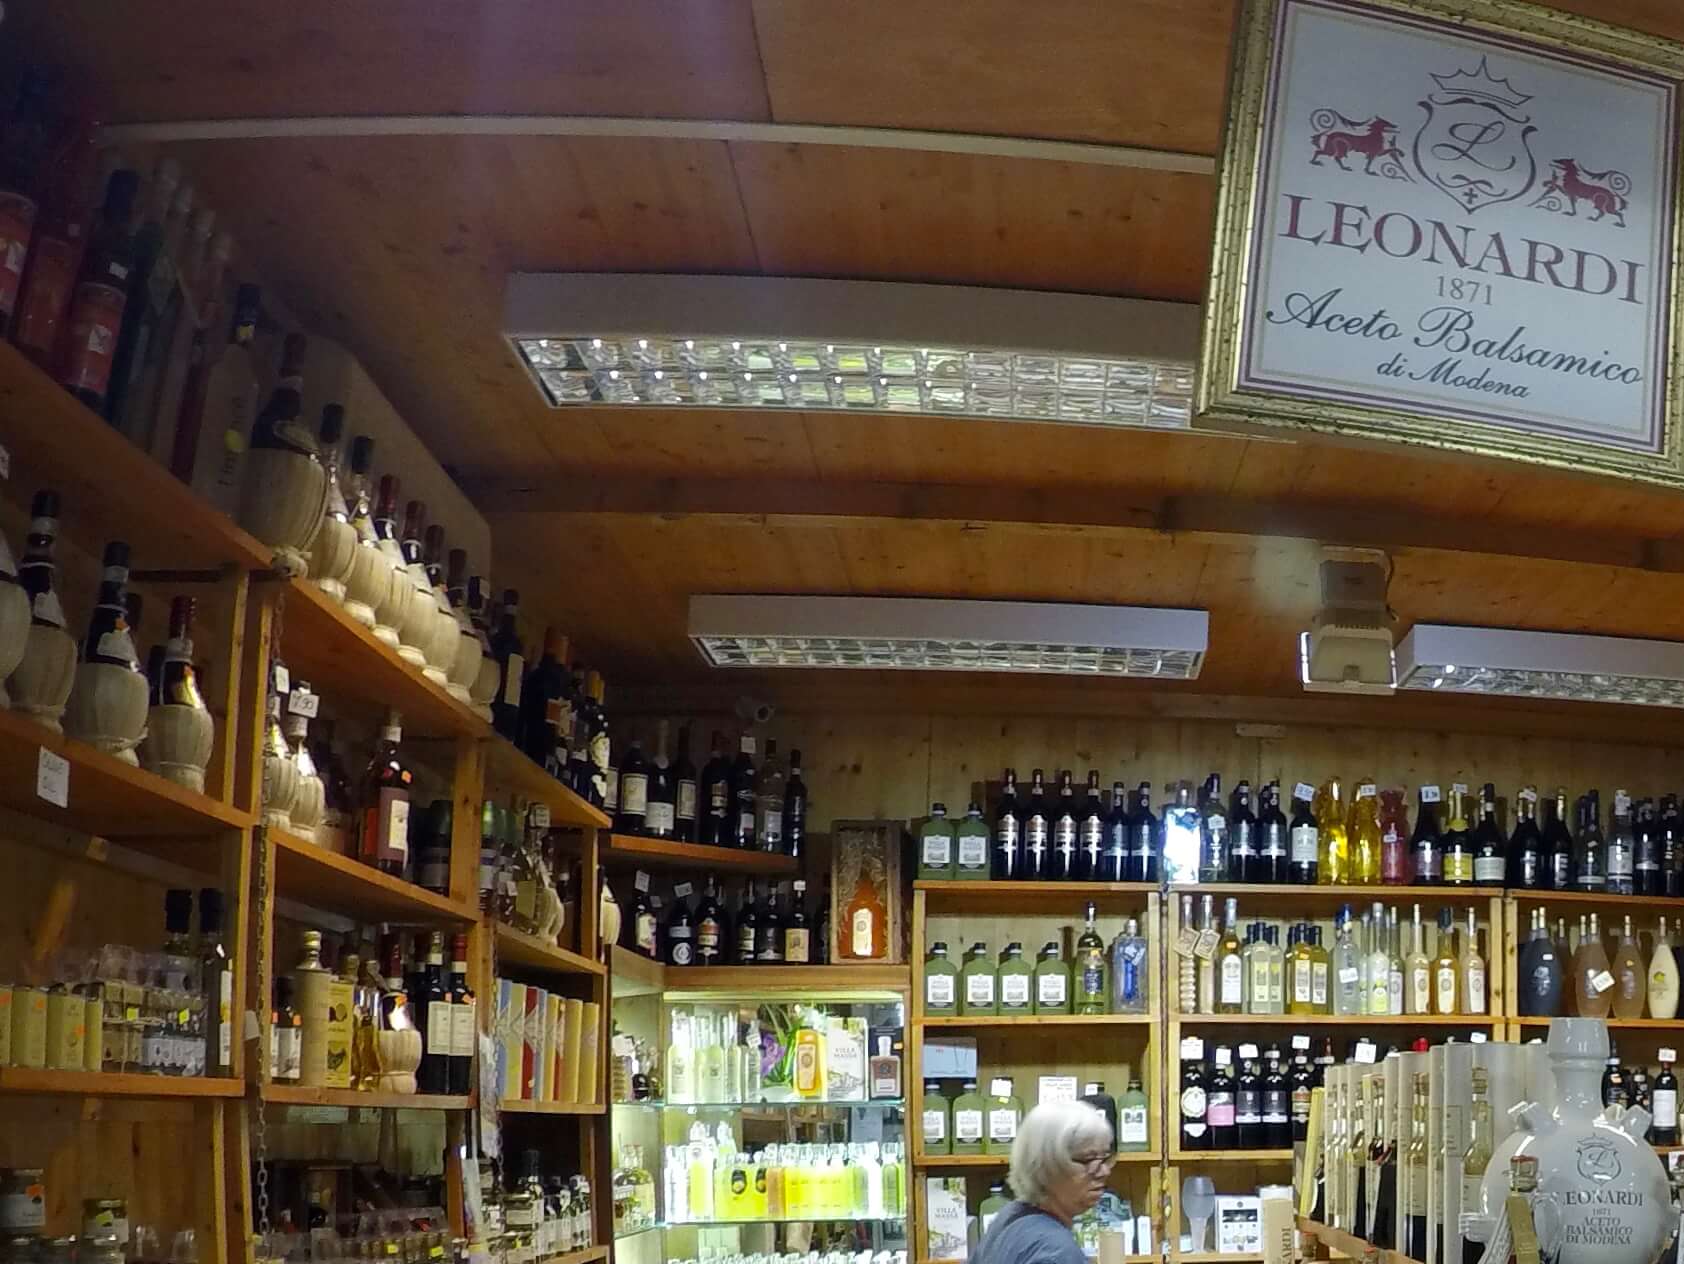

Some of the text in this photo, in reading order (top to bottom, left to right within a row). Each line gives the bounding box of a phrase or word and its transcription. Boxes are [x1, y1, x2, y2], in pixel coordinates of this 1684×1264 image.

[1279, 193, 1645, 305] LEONARDI
[1435, 275, 1494, 306] 1871
[1265, 288, 1644, 385] Aceto Balsamico
[1376, 353, 1531, 399] di Modena
